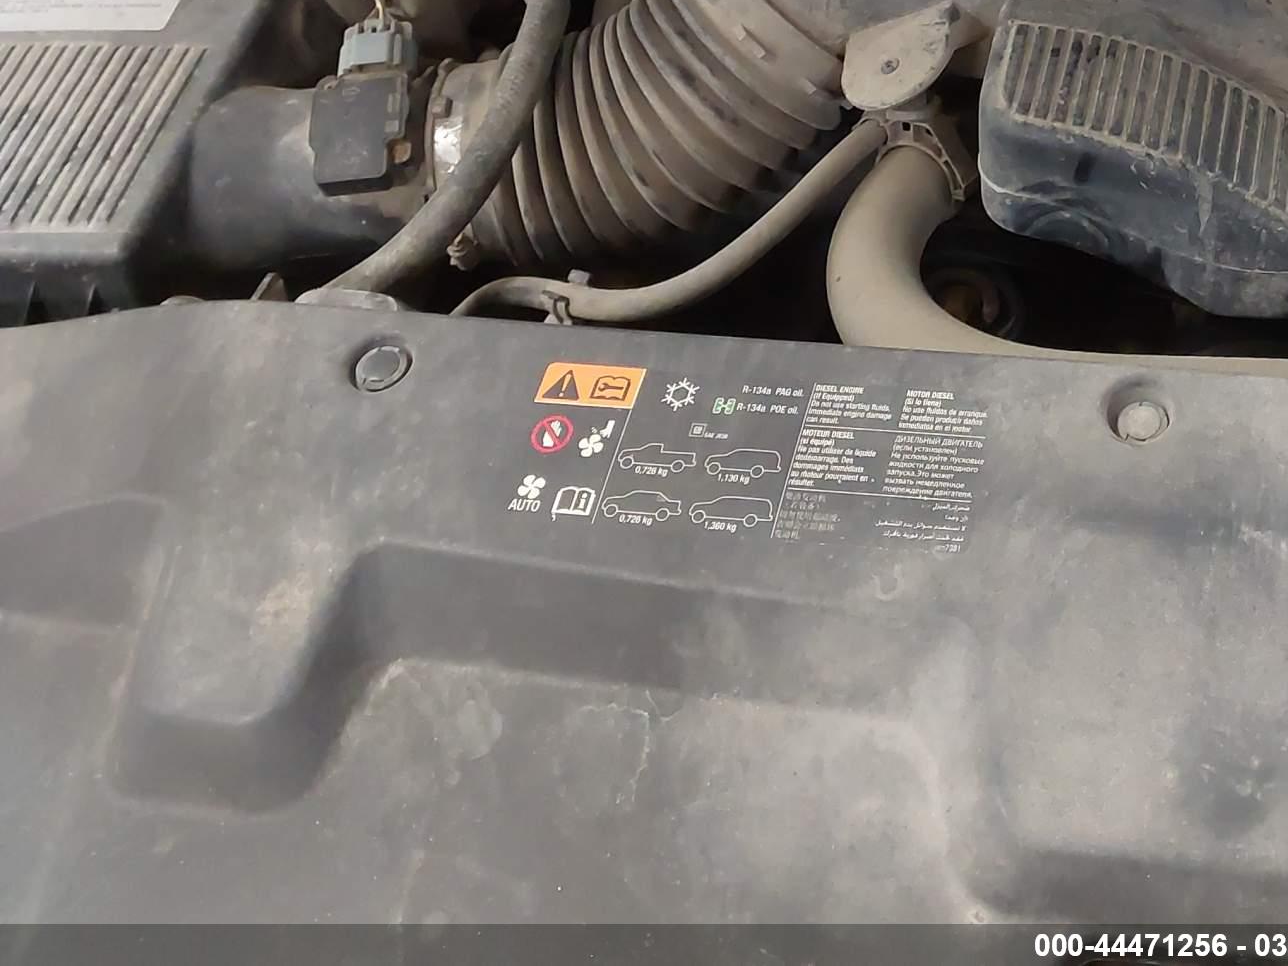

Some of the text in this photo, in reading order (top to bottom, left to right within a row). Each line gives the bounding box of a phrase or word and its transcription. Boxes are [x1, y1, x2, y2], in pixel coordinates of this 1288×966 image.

[742, 385, 772, 395] R-134a
[775, 387, 792, 397] PAG
[816, 385, 864, 395] DIESEL ENGINE
[906, 389, 955, 400] MOTOR DIESEL
[736, 403, 766, 413] R-134a
[769, 405, 787, 414] POE
[846, 403, 870, 412] starting
[809, 408, 892, 421] Immediate engine damage
[900, 413, 910, 421] Se
[910, 414, 934, 423] pueden
[802, 429, 855, 440] MOTEUR DIESEL
[894, 435, 983, 449] ДИЗЕЛЬНЫЙ ДВИГАТЕЛЬ
[656, 466, 669, 478] kg
[739, 474, 751, 485] kg
[507, 499, 541, 512] AUTO
[641, 517, 653, 527] kg
[726, 522, 737, 533] kg
